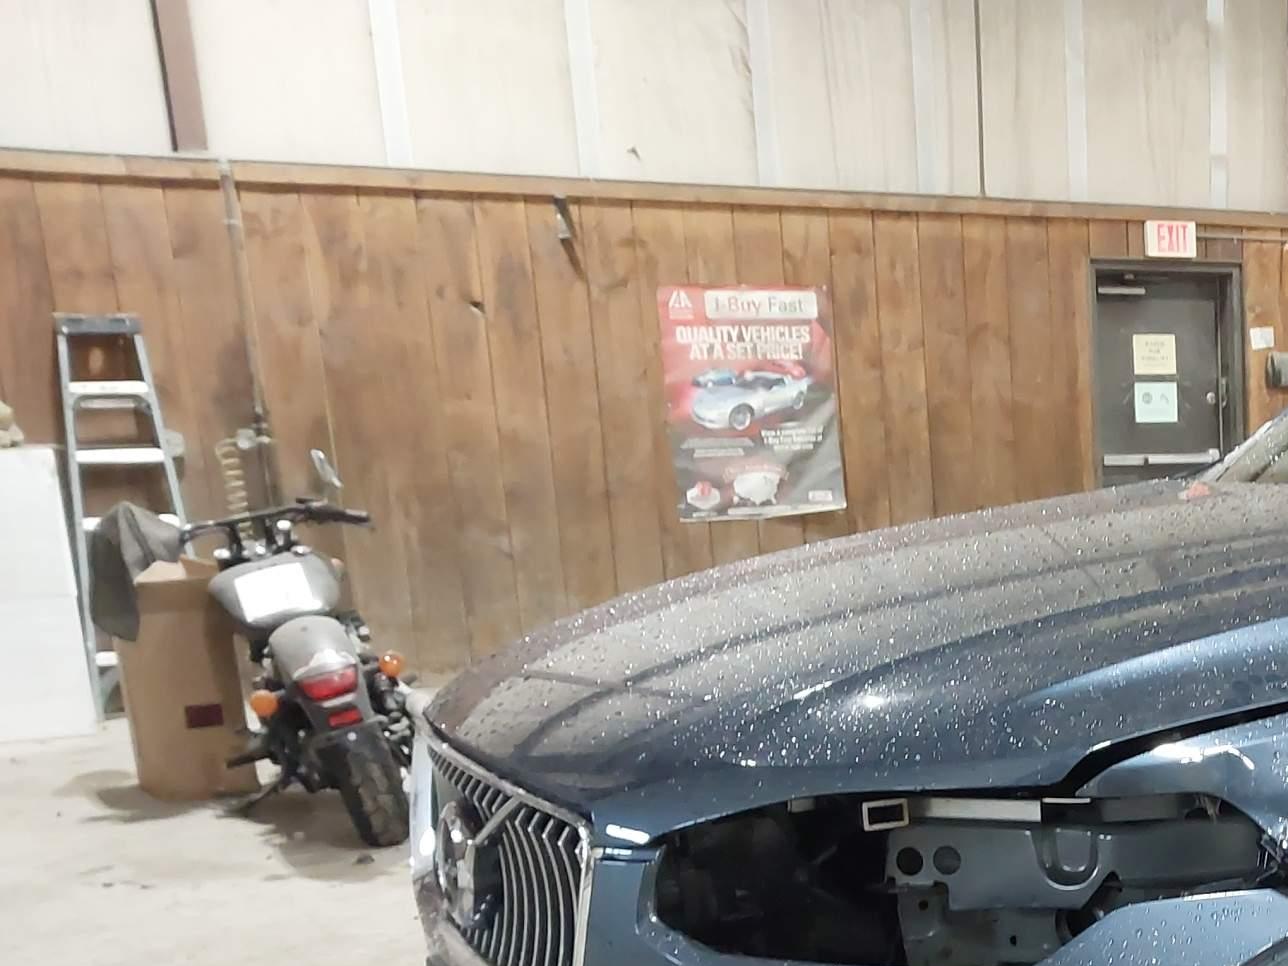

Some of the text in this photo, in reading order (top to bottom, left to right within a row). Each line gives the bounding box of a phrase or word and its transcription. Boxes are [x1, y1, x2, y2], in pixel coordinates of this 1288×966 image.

[1156, 223, 1189, 254] EXIT
[767, 295, 805, 313] Fast
[675, 325, 811, 344] QUALITY VEHICLES
[689, 343, 803, 361] AT A SET PRICE!
